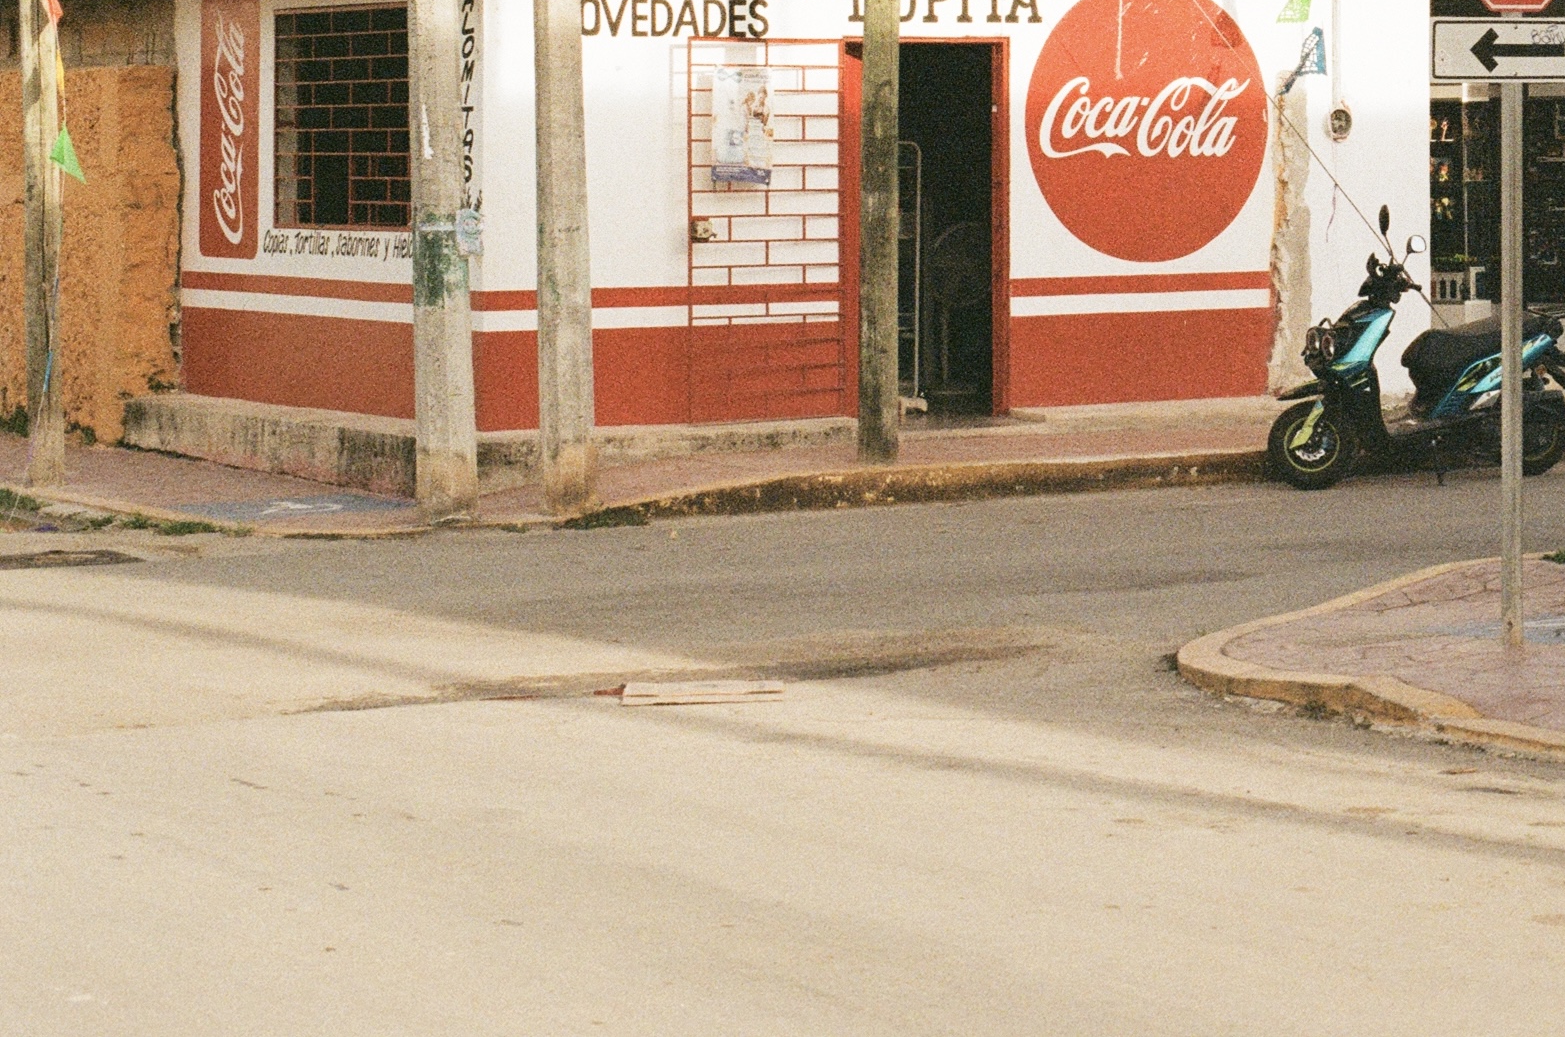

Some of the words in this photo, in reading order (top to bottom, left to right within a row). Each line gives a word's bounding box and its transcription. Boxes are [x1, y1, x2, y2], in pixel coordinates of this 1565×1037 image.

[213, 9, 245, 245] Coca-Cola
[1039, 76, 1251, 159] Coca-Cola
[383, 238, 390, 262] y
